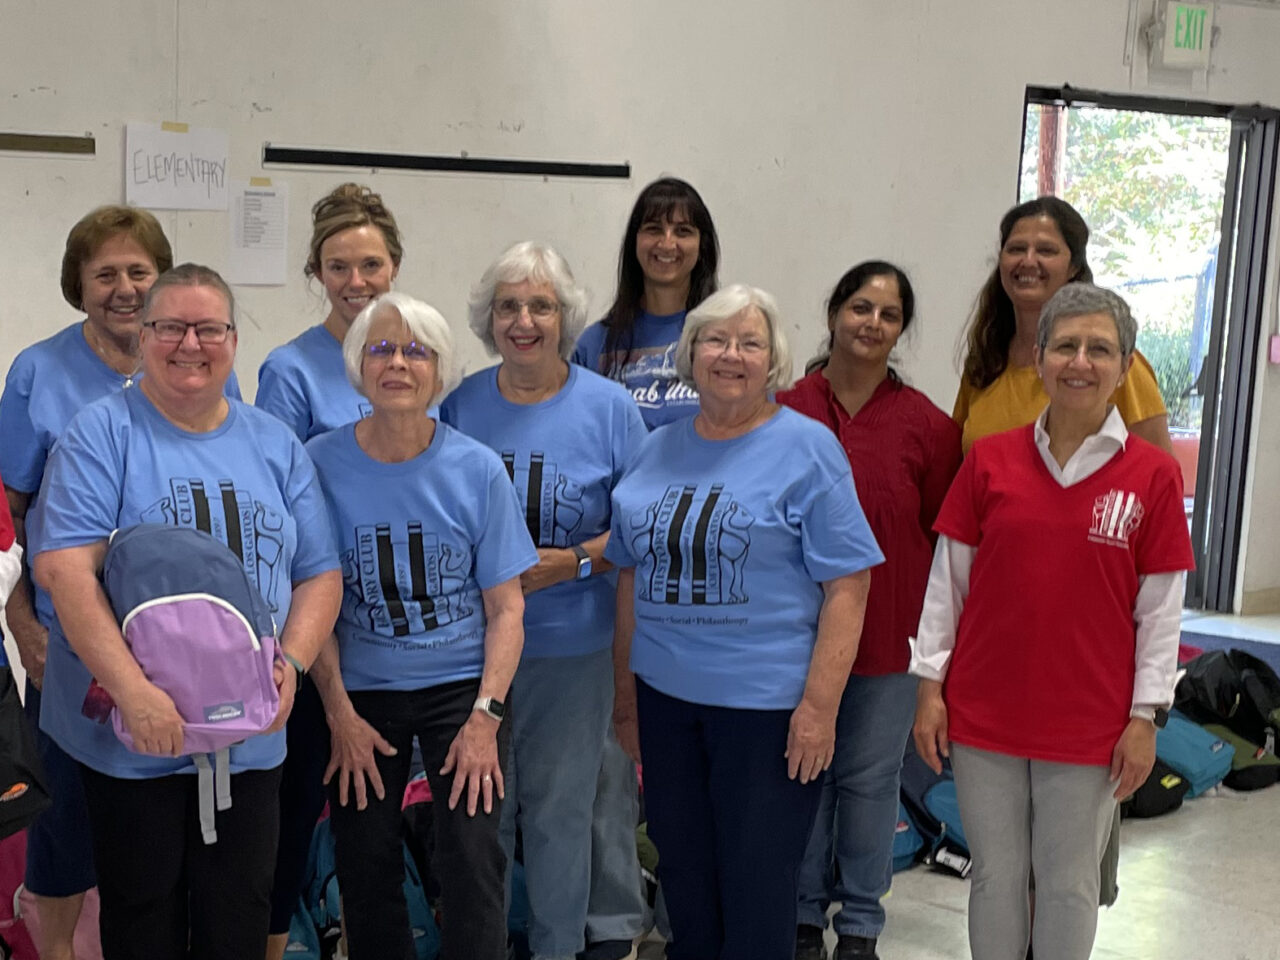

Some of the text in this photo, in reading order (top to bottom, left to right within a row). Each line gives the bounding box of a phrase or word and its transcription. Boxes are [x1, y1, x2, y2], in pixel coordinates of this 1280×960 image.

[1174, 6, 1207, 50] EXIT
[133, 150, 226, 199] ELEMENTARY
[176, 484, 192, 525] CLUB
[242, 510, 256, 575] LOS GATOS
[360, 533, 375, 575] CLUB
[654, 490, 679, 592] HISTORY CLUB
